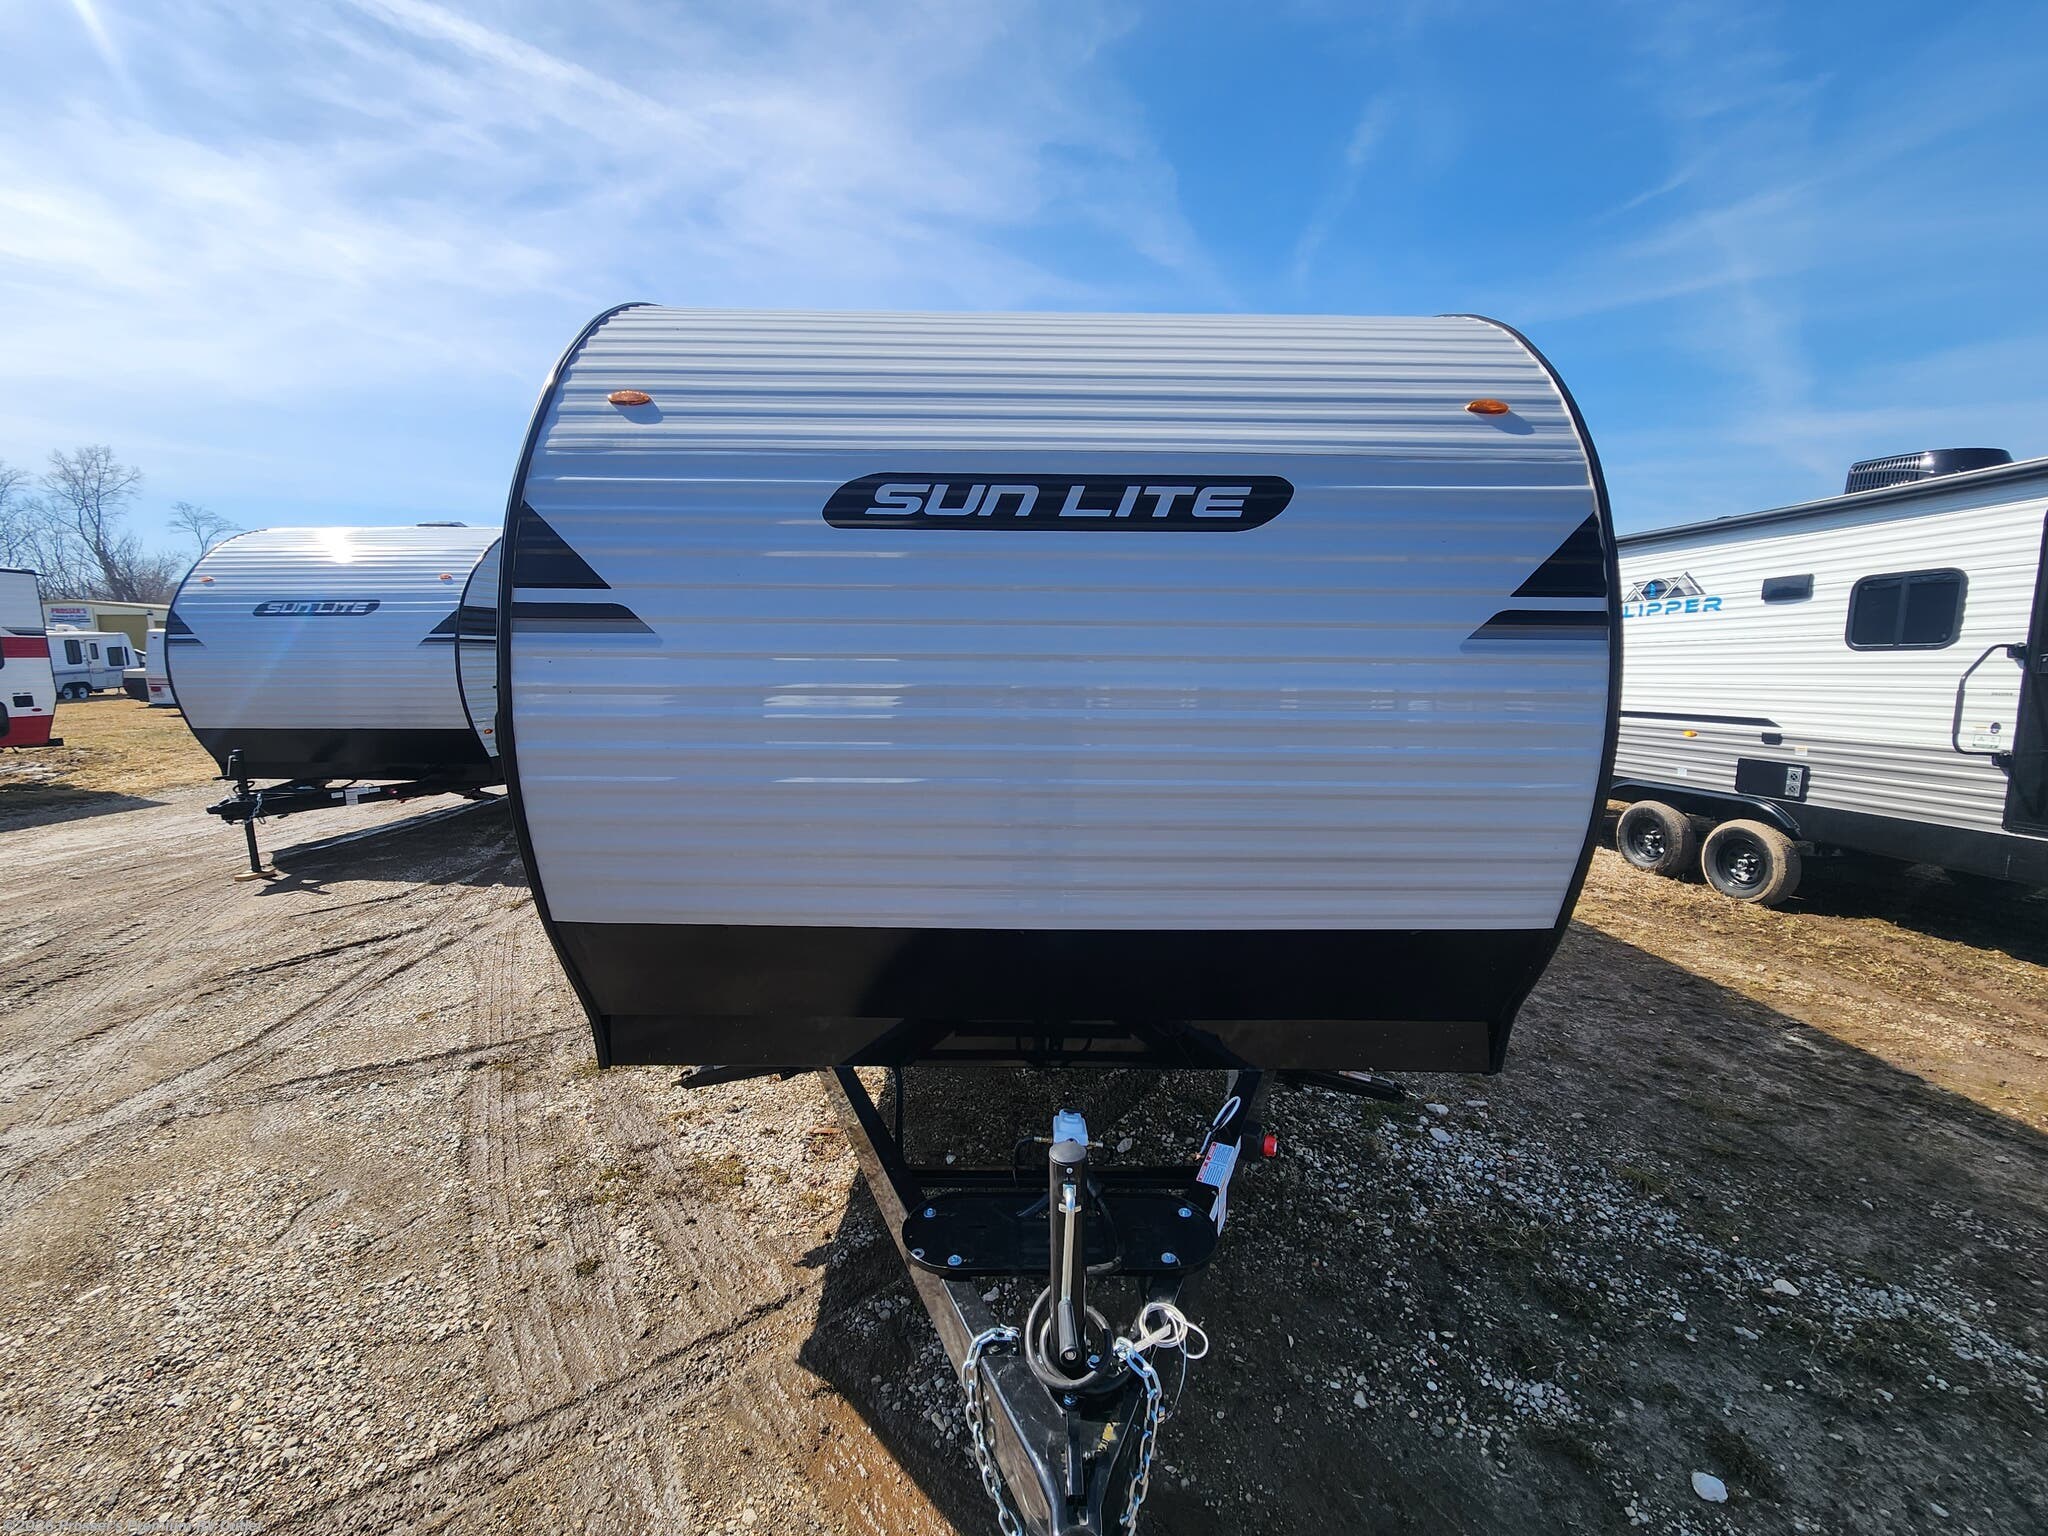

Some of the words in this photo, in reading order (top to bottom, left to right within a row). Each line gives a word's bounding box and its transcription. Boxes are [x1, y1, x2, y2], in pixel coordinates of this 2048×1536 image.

[864, 483, 1040, 517] SUN
[1058, 485, 1252, 518] LITE
[315, 602, 369, 613] LITE
[1622, 596, 1722, 618] LIPPER
